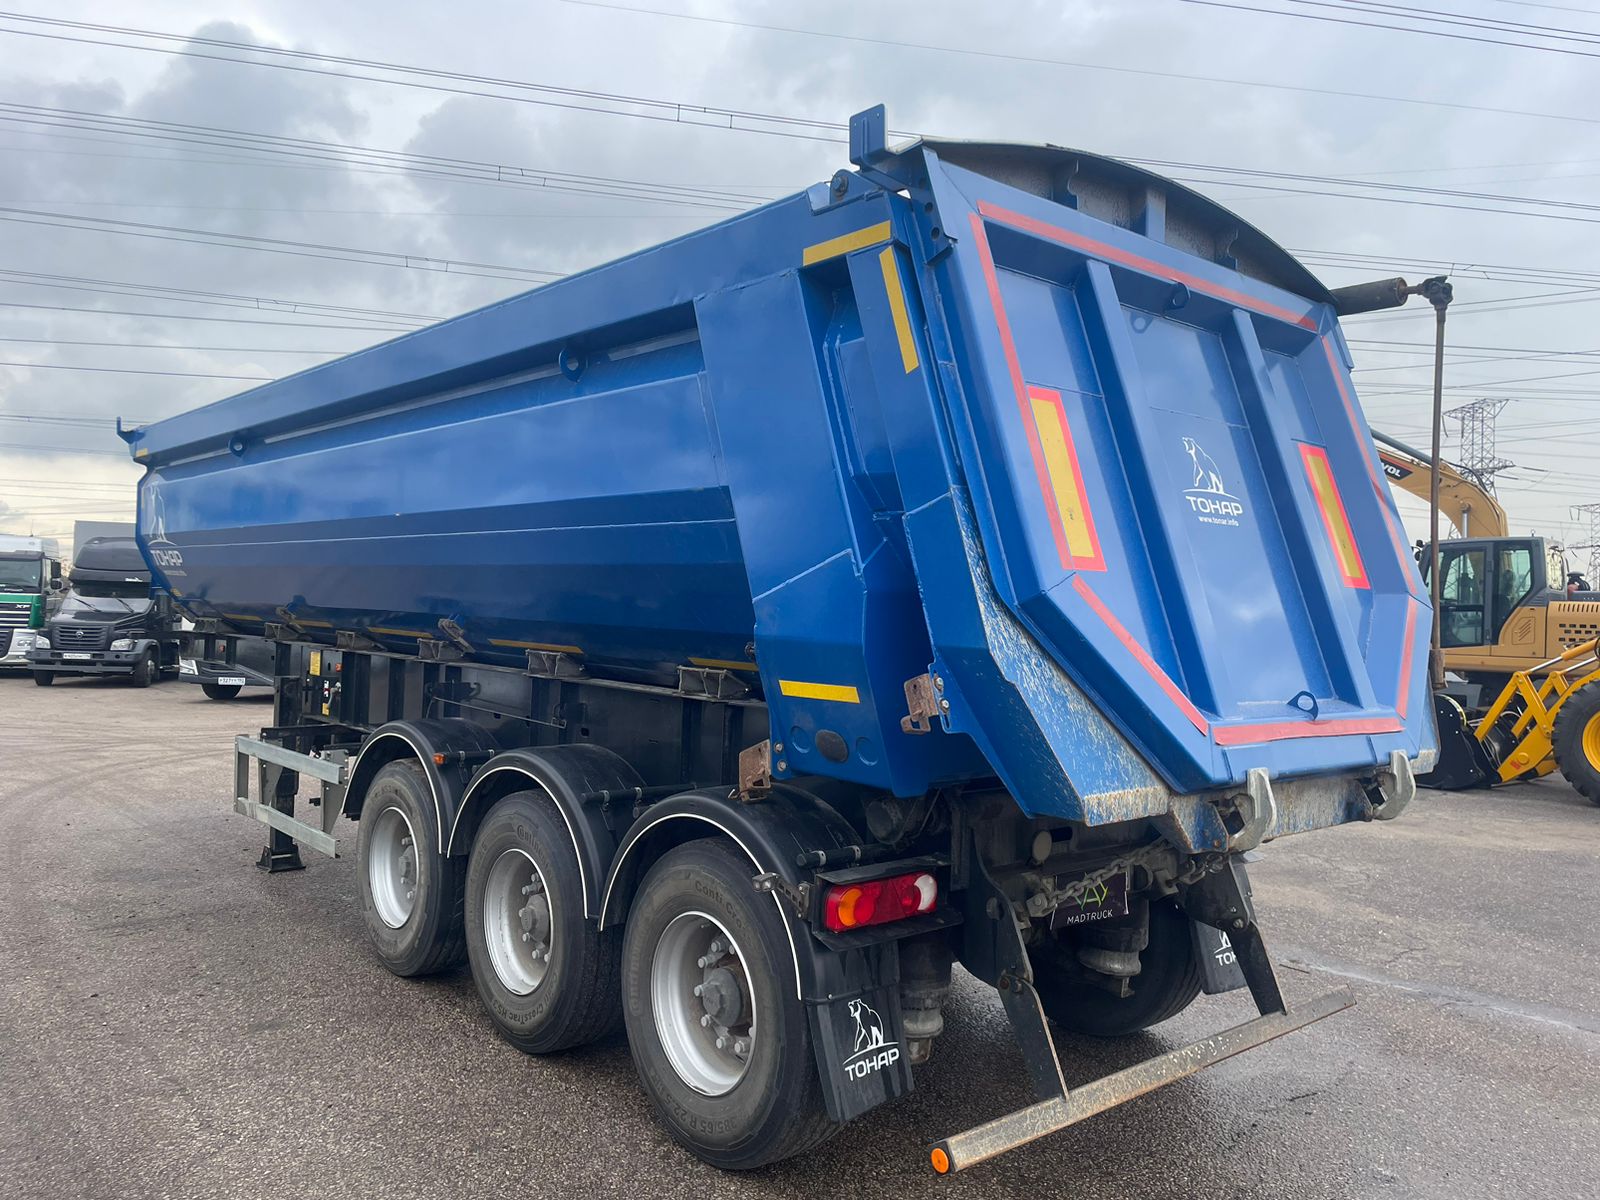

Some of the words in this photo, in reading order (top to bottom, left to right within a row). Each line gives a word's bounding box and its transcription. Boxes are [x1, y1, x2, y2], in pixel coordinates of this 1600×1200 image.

[1185, 495, 1243, 516] ТОНАР
[150, 550, 183, 566] ТОНАР
[1067, 909, 1113, 925] MADTRUCK
[844, 1048, 899, 1081] ТОНАР
